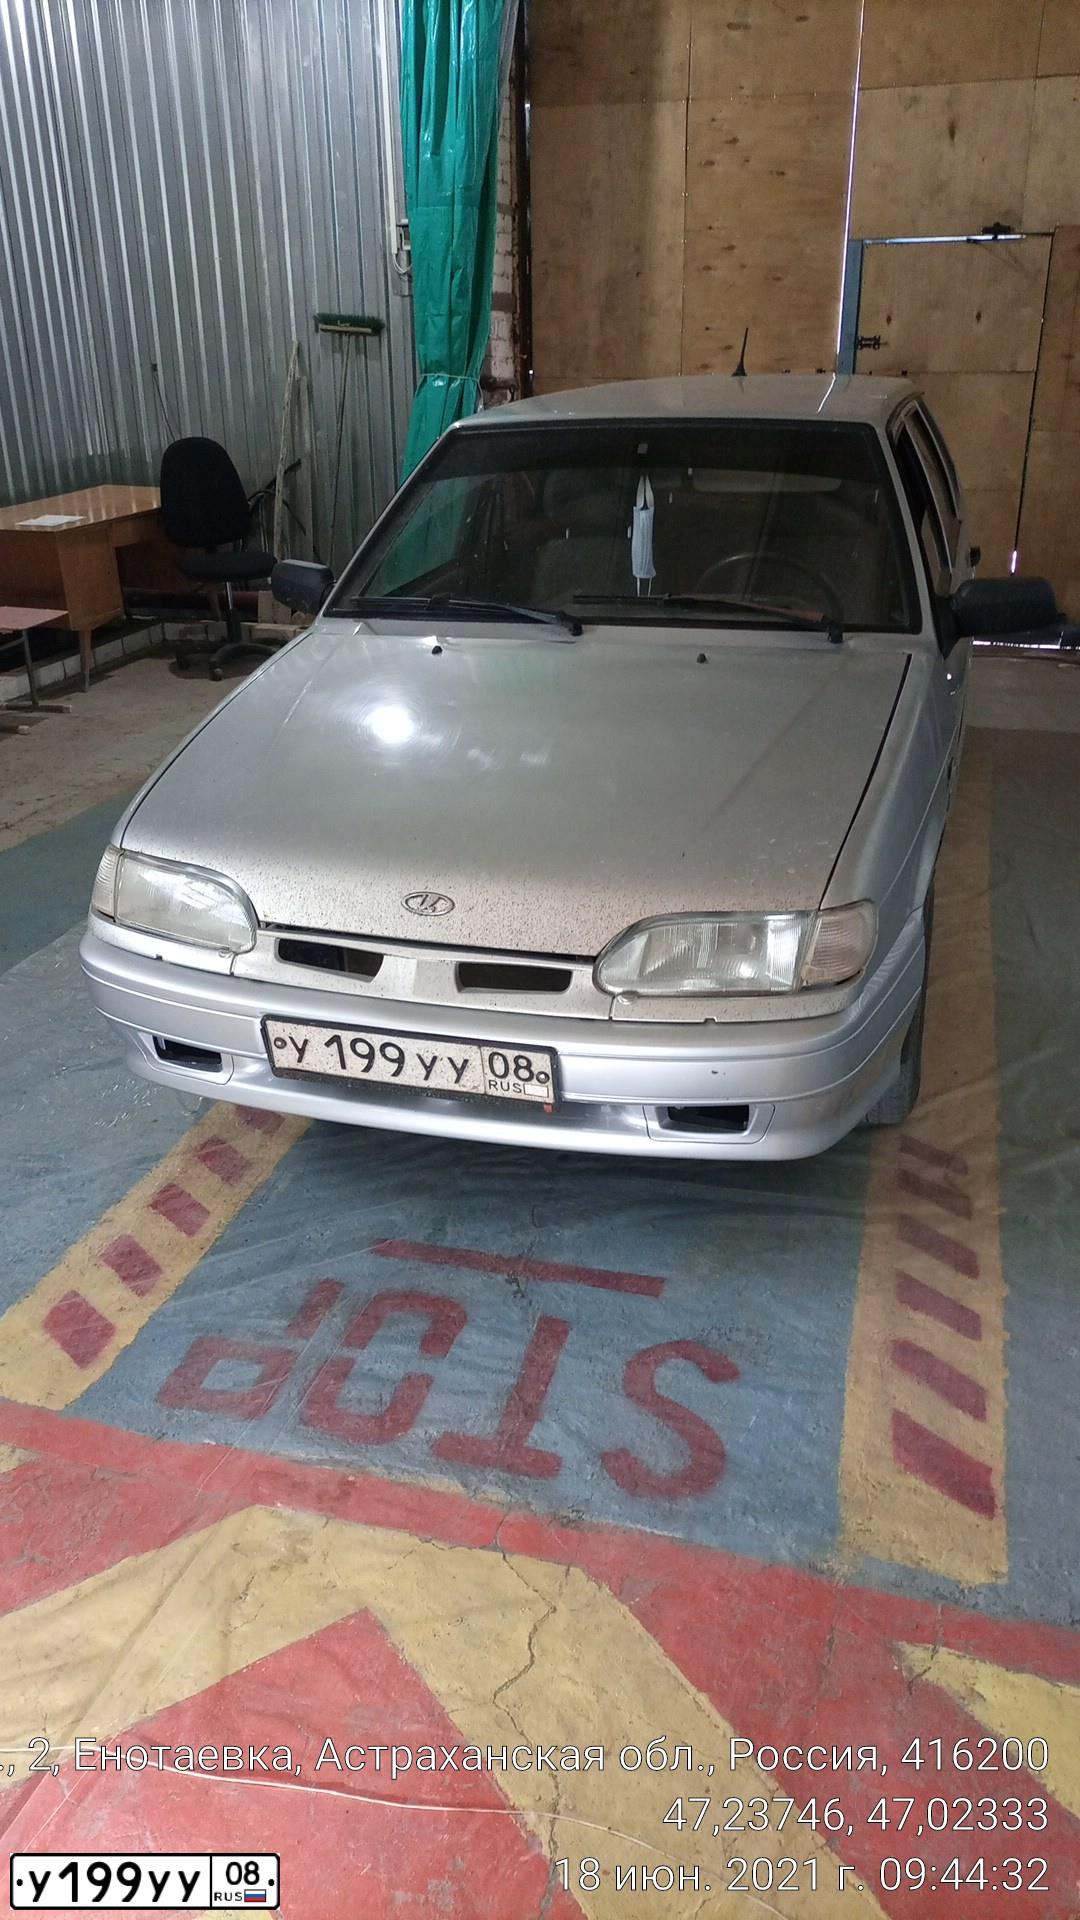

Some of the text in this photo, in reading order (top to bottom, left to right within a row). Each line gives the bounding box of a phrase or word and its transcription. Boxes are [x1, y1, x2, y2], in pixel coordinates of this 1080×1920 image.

[487, 1050, 535, 1083] 08
[488, 1079, 523, 1094] RUS
[156, 1278, 741, 1500] STOP
